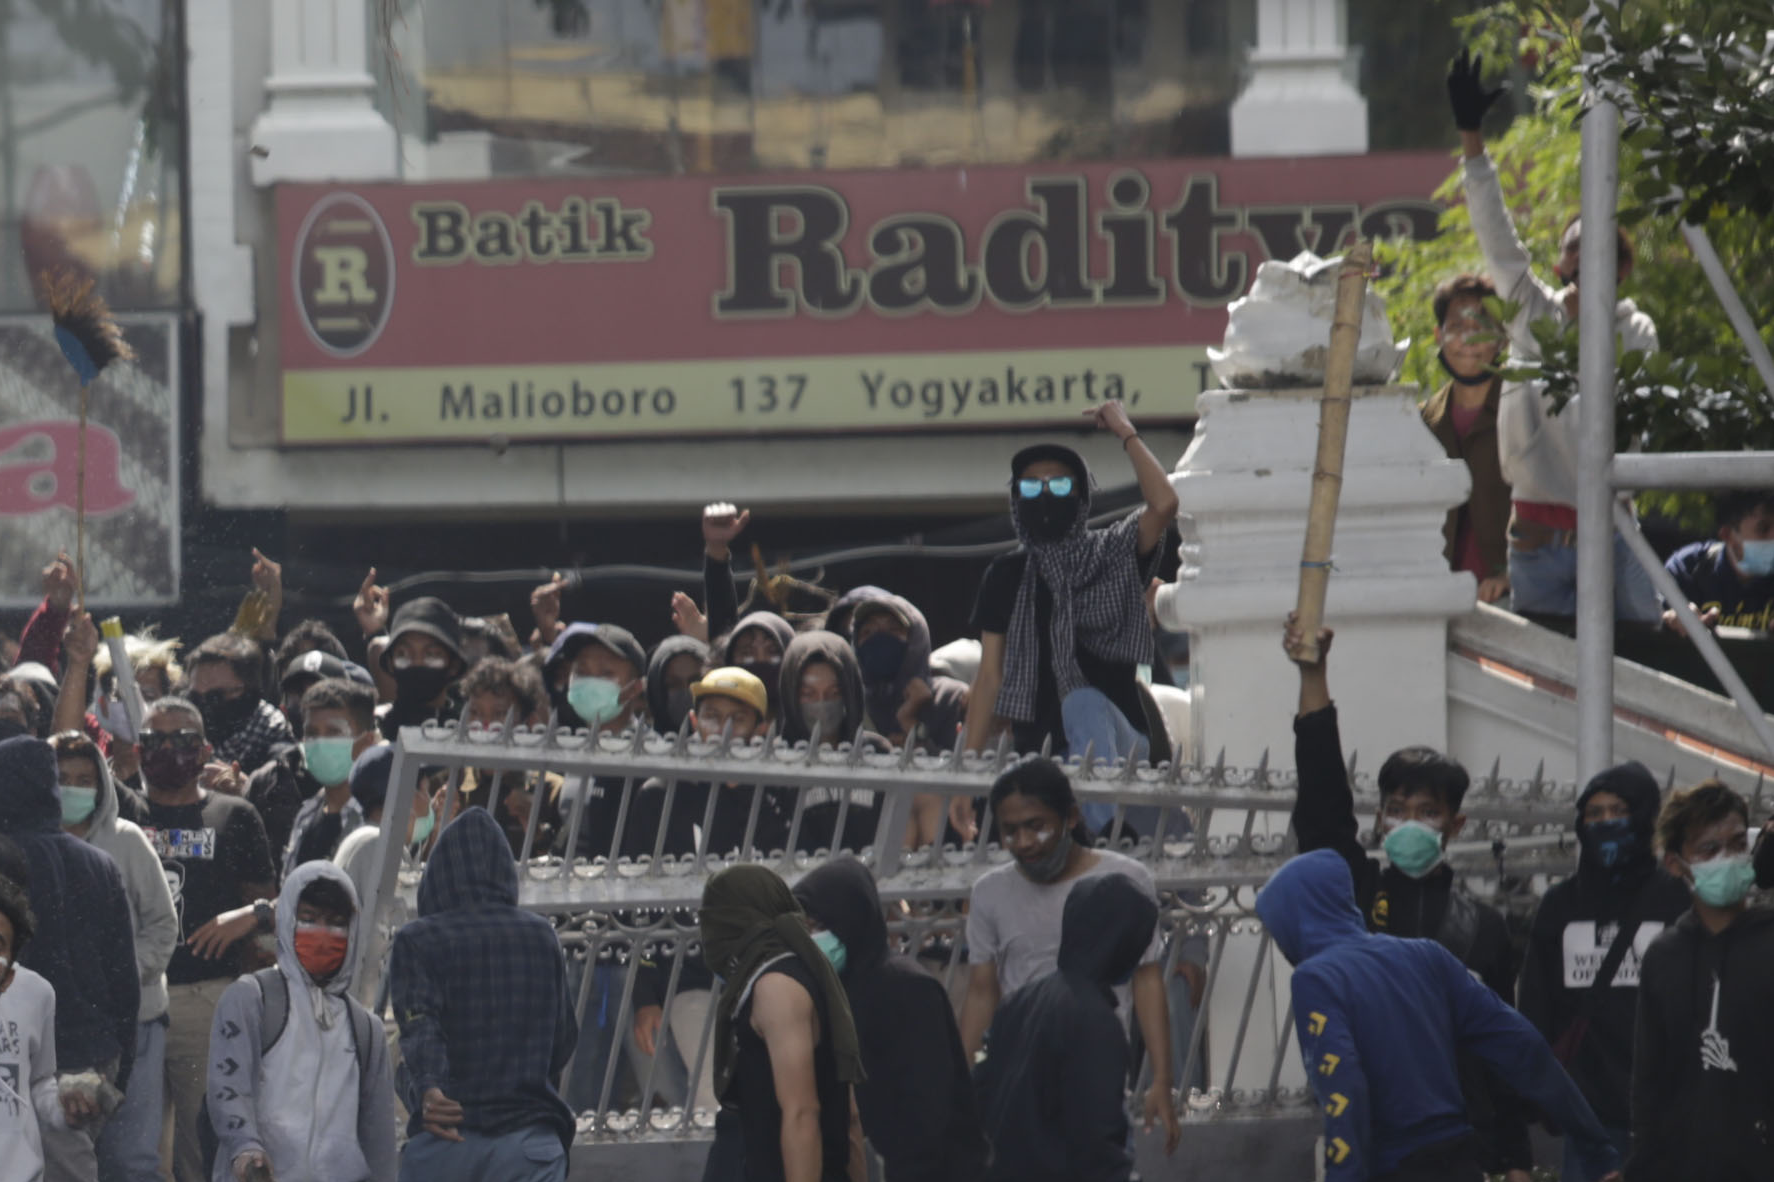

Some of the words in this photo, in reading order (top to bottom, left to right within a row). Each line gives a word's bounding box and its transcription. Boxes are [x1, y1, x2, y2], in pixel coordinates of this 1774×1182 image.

[412, 195, 654, 266] Batik
[313, 246, 376, 305] R
[340, 386, 391, 425] Jl.
[439, 379, 677, 422] Malioboro
[728, 374, 810, 415] 137
[859, 365, 1142, 419] Yogyakarta,
